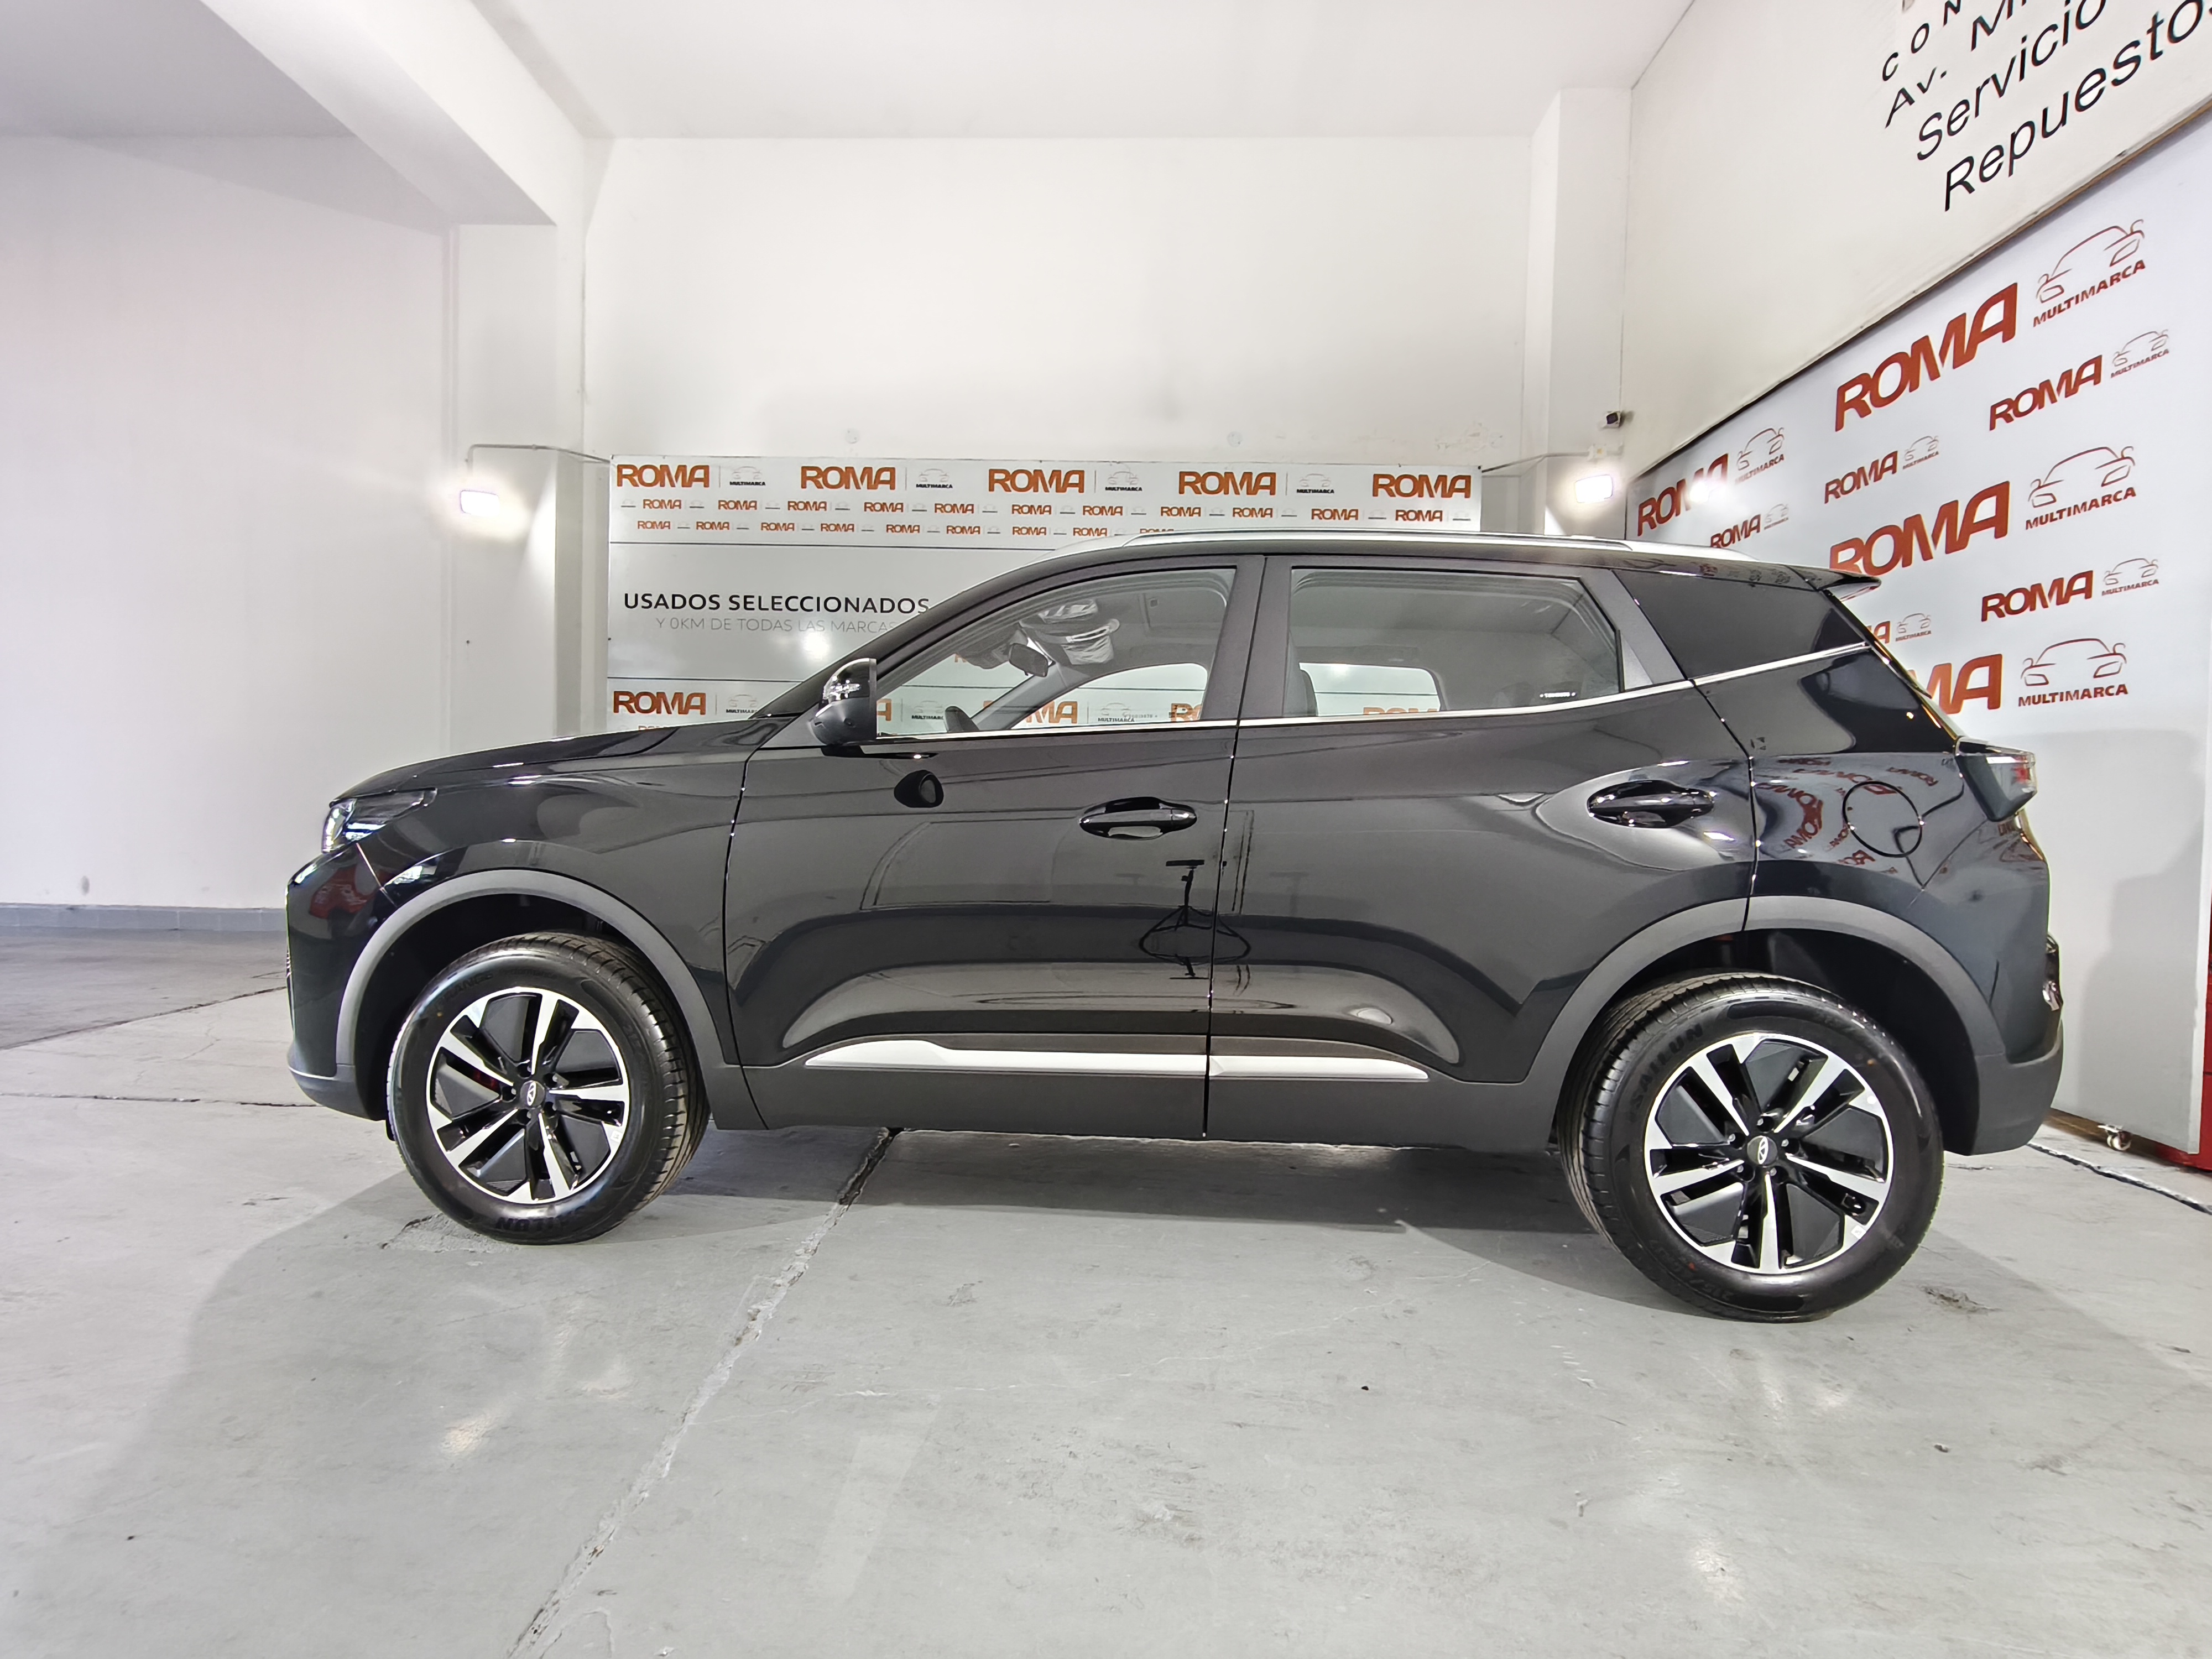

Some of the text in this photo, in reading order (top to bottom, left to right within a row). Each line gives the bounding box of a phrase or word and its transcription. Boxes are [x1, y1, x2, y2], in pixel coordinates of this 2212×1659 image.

[1886, 0, 2027, 128] Av. M
[1945, 0, 2212, 211] Repuesto
[1835, 259, 2146, 432] ROMA MULTIMARCA
[1990, 348, 2169, 431] ROMA MULTIMARCA
[616, 465, 710, 488] ROMA
[800, 466, 896, 491] ROMA
[988, 469, 1086, 494] ROMA
[1824, 451, 1898, 504] ROMA
[1178, 471, 1277, 496] ROMA
[1373, 474, 1472, 499] ROMA
[643, 499, 681, 509] ROMA
[718, 500, 757, 510] ROMA
[787, 501, 827, 511] ROMA
[864, 502, 904, 513] ROMA
[935, 504, 974, 514] ROMA
[1011, 505, 1052, 515] ROMA
[1082, 506, 1123, 517] ROMA
[1160, 507, 1201, 517] ROMA
[1233, 508, 1273, 518] ROMA
[1312, 509, 1359, 521] ROMA
[1395, 510, 1443, 522] ROMA
[637, 521, 671, 530] ROMA
[696, 522, 730, 531] ROMA
[760, 523, 795, 531] ROMA
[820, 524, 855, 532] ROMA
[886, 525, 920, 534] ROMA
[946, 526, 981, 535] ROMA
[1013, 527, 1046, 536] ROMA
[1710, 514, 1761, 548] ROMA
[1829, 481, 2137, 576] ROMA MULTIMARCA
[1073, 528, 1108, 537] ROMA
[1981, 570, 2159, 622] ROMA MULTIMARCA
[624, 593, 930, 615] USADOS SELECCIONADOS
[656, 618, 665, 629] Y
[711, 618, 732, 630] DE
[738, 618, 793, 632] TODAS
[798, 619, 826, 633] LAS
[1908, 653, 2129, 714] MA MULTIMARCA
[613, 691, 706, 716] ROMA
